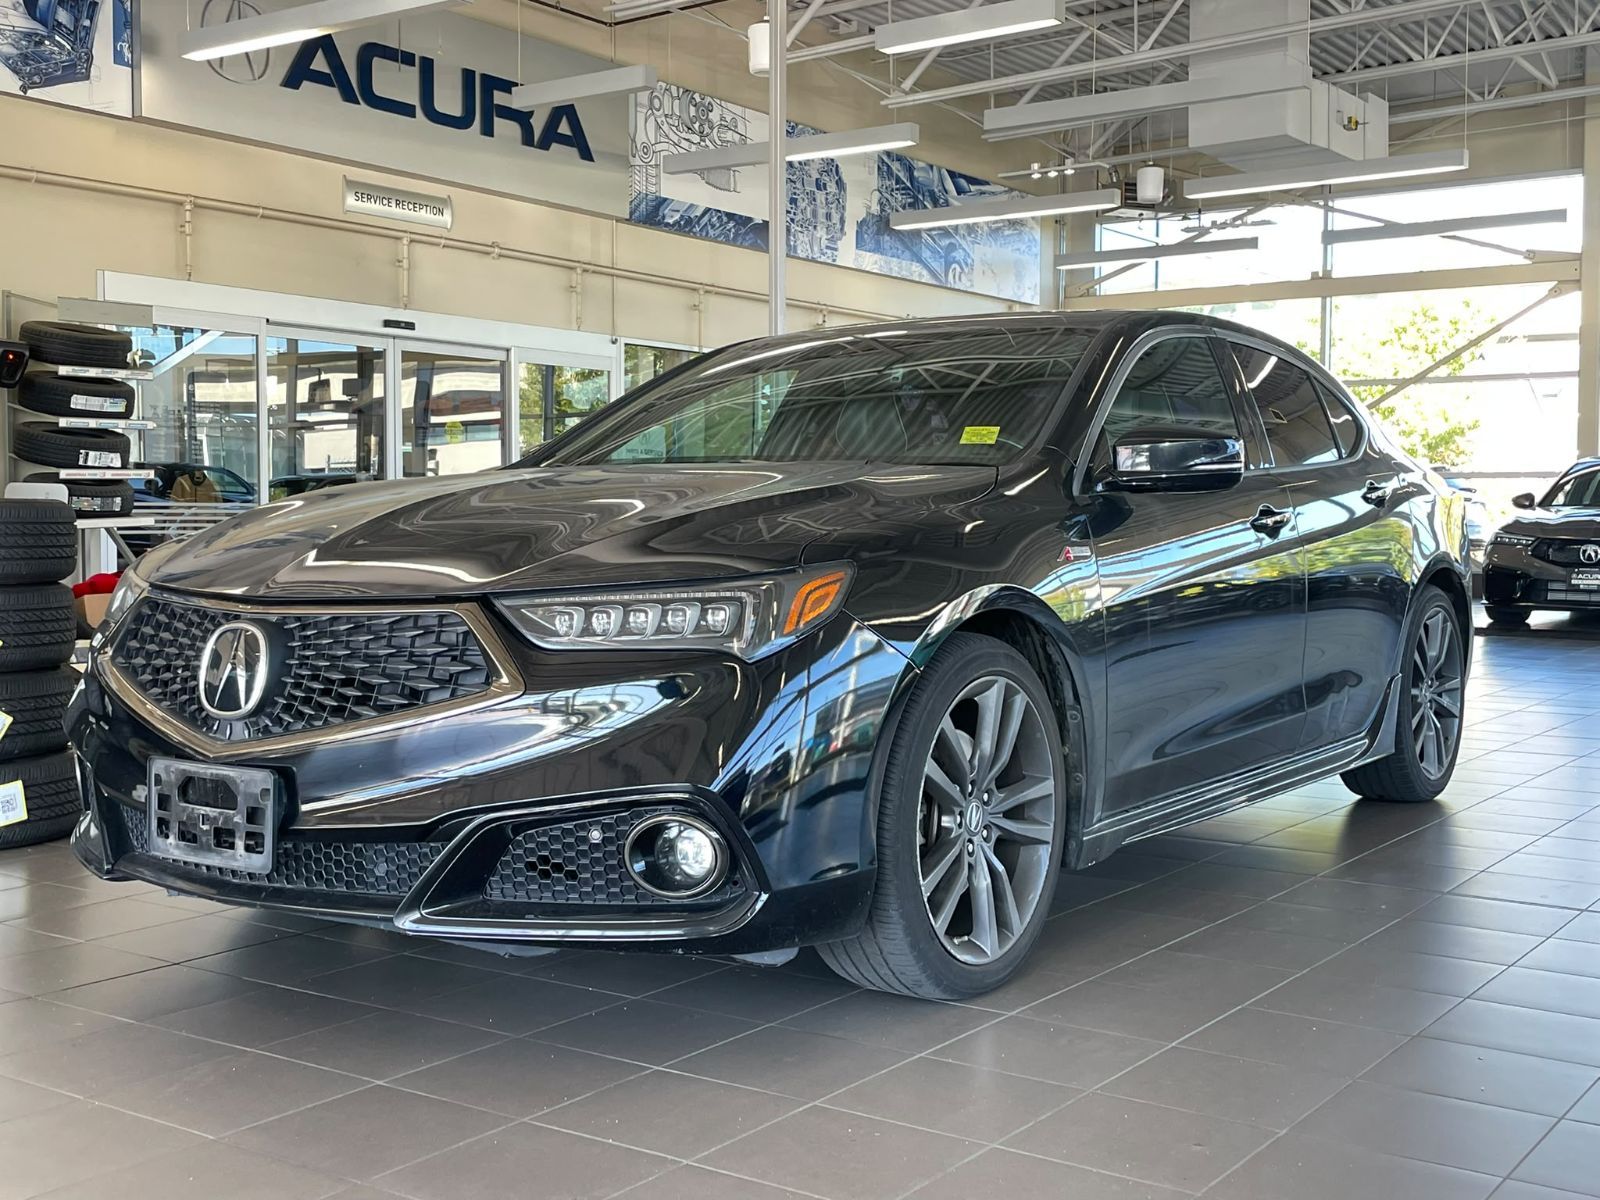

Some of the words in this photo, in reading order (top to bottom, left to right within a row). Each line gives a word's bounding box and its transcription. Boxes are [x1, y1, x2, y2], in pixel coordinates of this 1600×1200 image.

[280, 33, 595, 162] ACURA
[354, 191, 393, 208] SERVICE
[395, 198, 444, 217] RECEPTION
